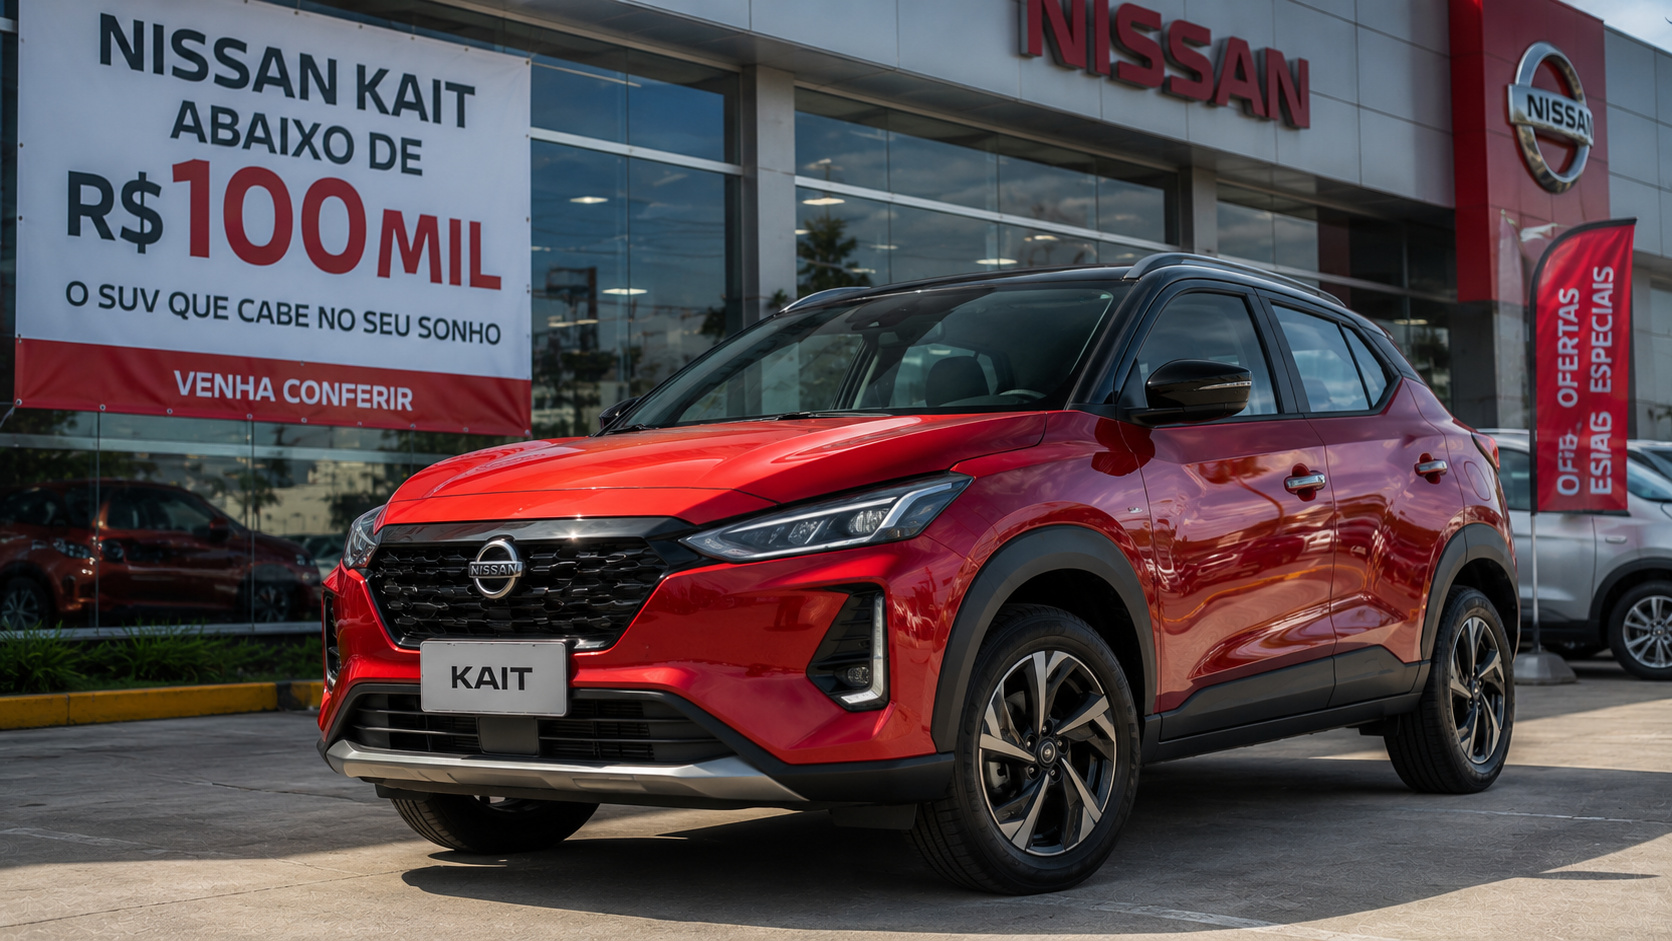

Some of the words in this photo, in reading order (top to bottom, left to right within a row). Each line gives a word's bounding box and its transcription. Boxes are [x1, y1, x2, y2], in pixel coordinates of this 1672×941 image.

[99, 12, 338, 106] NISSAN
[356, 63, 476, 129] KAIT
[1021, 0, 1309, 129] NISSAN
[170, 99, 355, 165] ABAIXO
[369, 131, 423, 177] DE
[1526, 93, 1594, 139] NISSAN
[377, 208, 502, 291] MIL
[65, 280, 89, 307] O
[98, 283, 160, 313] SUV
[168, 291, 229, 321] QUE
[237, 298, 310, 328] CABE
[318, 306, 356, 332] NO
[363, 310, 411, 337] SEU
[418, 316, 501, 346] SONHO
[1557, 287, 1580, 408] OFERTAS
[1589, 265, 1615, 393] ESPECIAIS
[173, 370, 276, 402] VENHA
[282, 378, 413, 412] CONFERIR
[470, 564, 518, 576] NISSAN
[451, 665, 533, 691] KAIT
